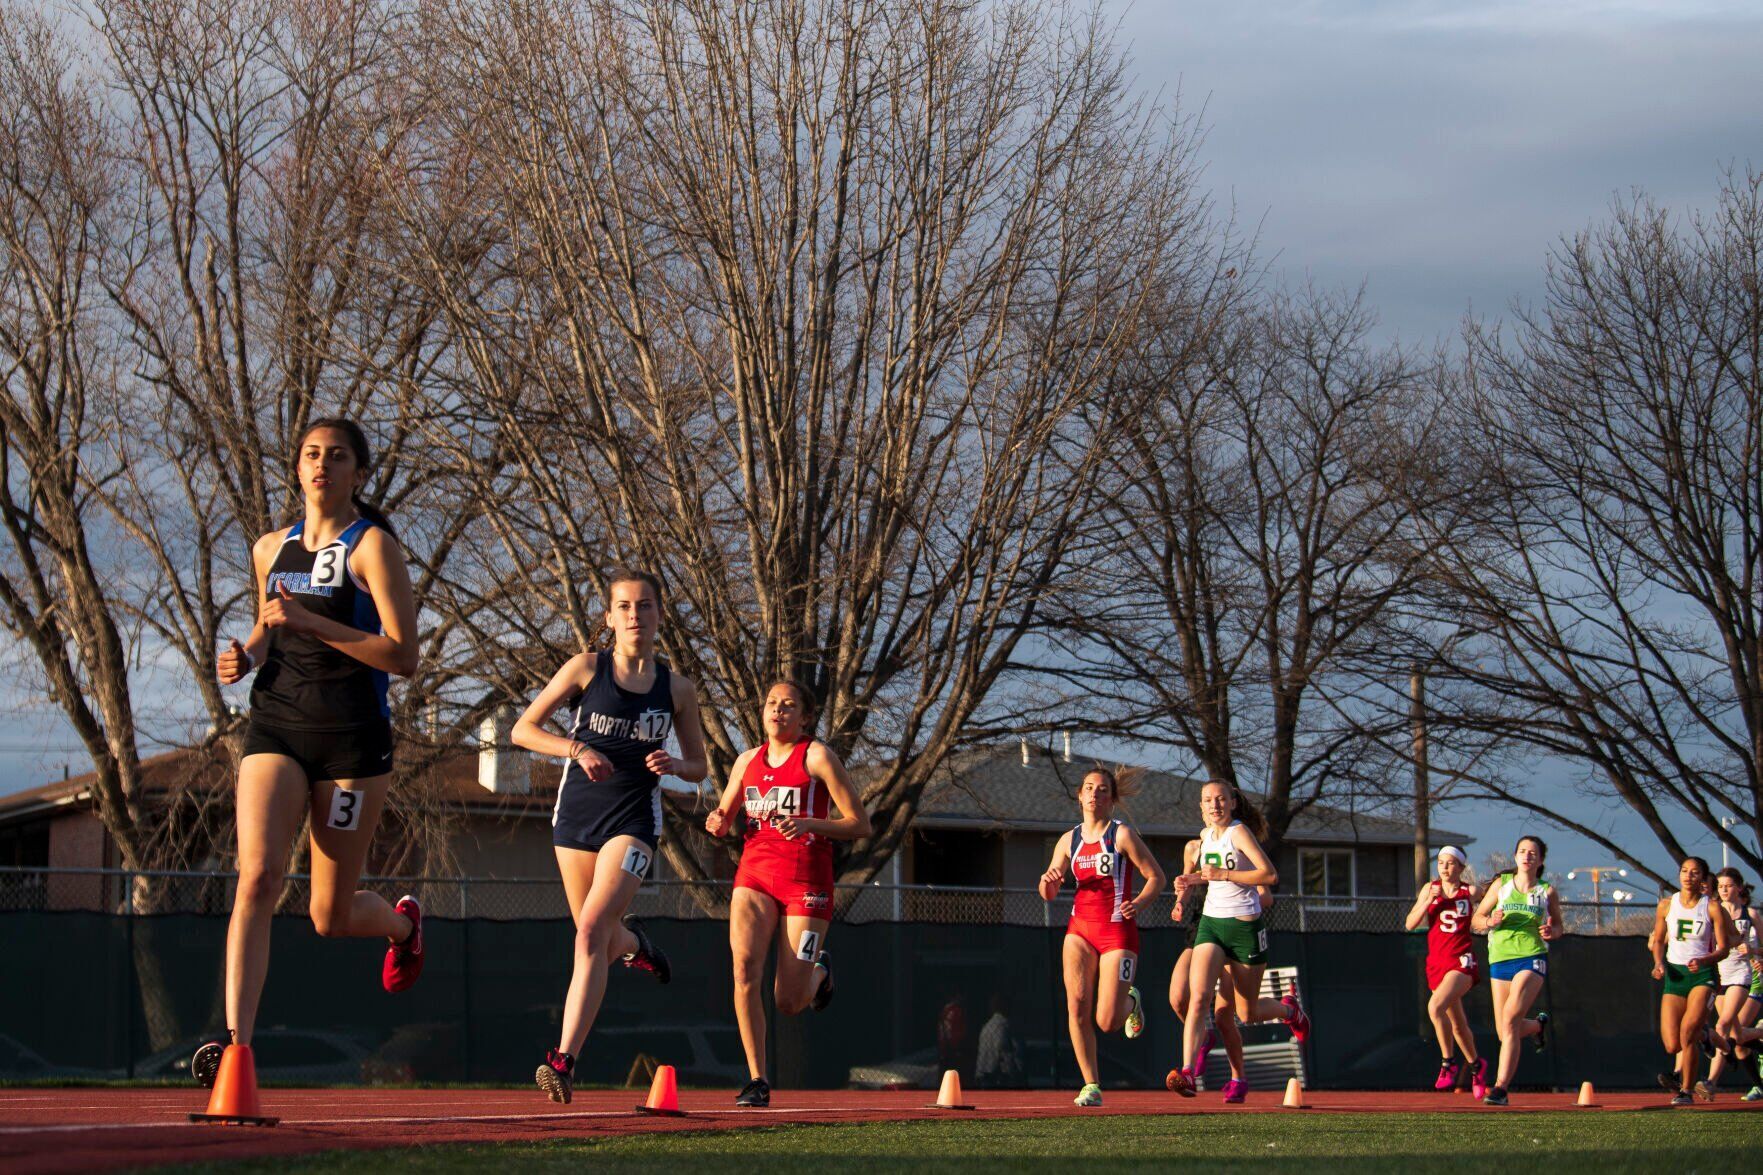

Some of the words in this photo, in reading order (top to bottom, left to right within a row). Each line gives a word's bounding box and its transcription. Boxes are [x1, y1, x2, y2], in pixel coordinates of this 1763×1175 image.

[317, 549, 337, 584] 3
[589, 711, 630, 738] NORTH
[645, 714, 665, 739] 12
[333, 791, 357, 829] 3
[781, 788, 796, 815] 4
[630, 850, 649, 879] 12
[1078, 861, 1097, 870] SOUT
[1099, 853, 1111, 875] 8
[1225, 851, 1236, 870] 6
[1458, 900, 1467, 916] 2
[1530, 893, 1541, 905] 11
[1439, 909, 1458, 934] S
[1676, 918, 1694, 941] F
[1695, 920, 1704, 936] 7
[1738, 920, 1750, 931] 14
[801, 932, 816, 961] 4
[1122, 957, 1131, 981] 8
